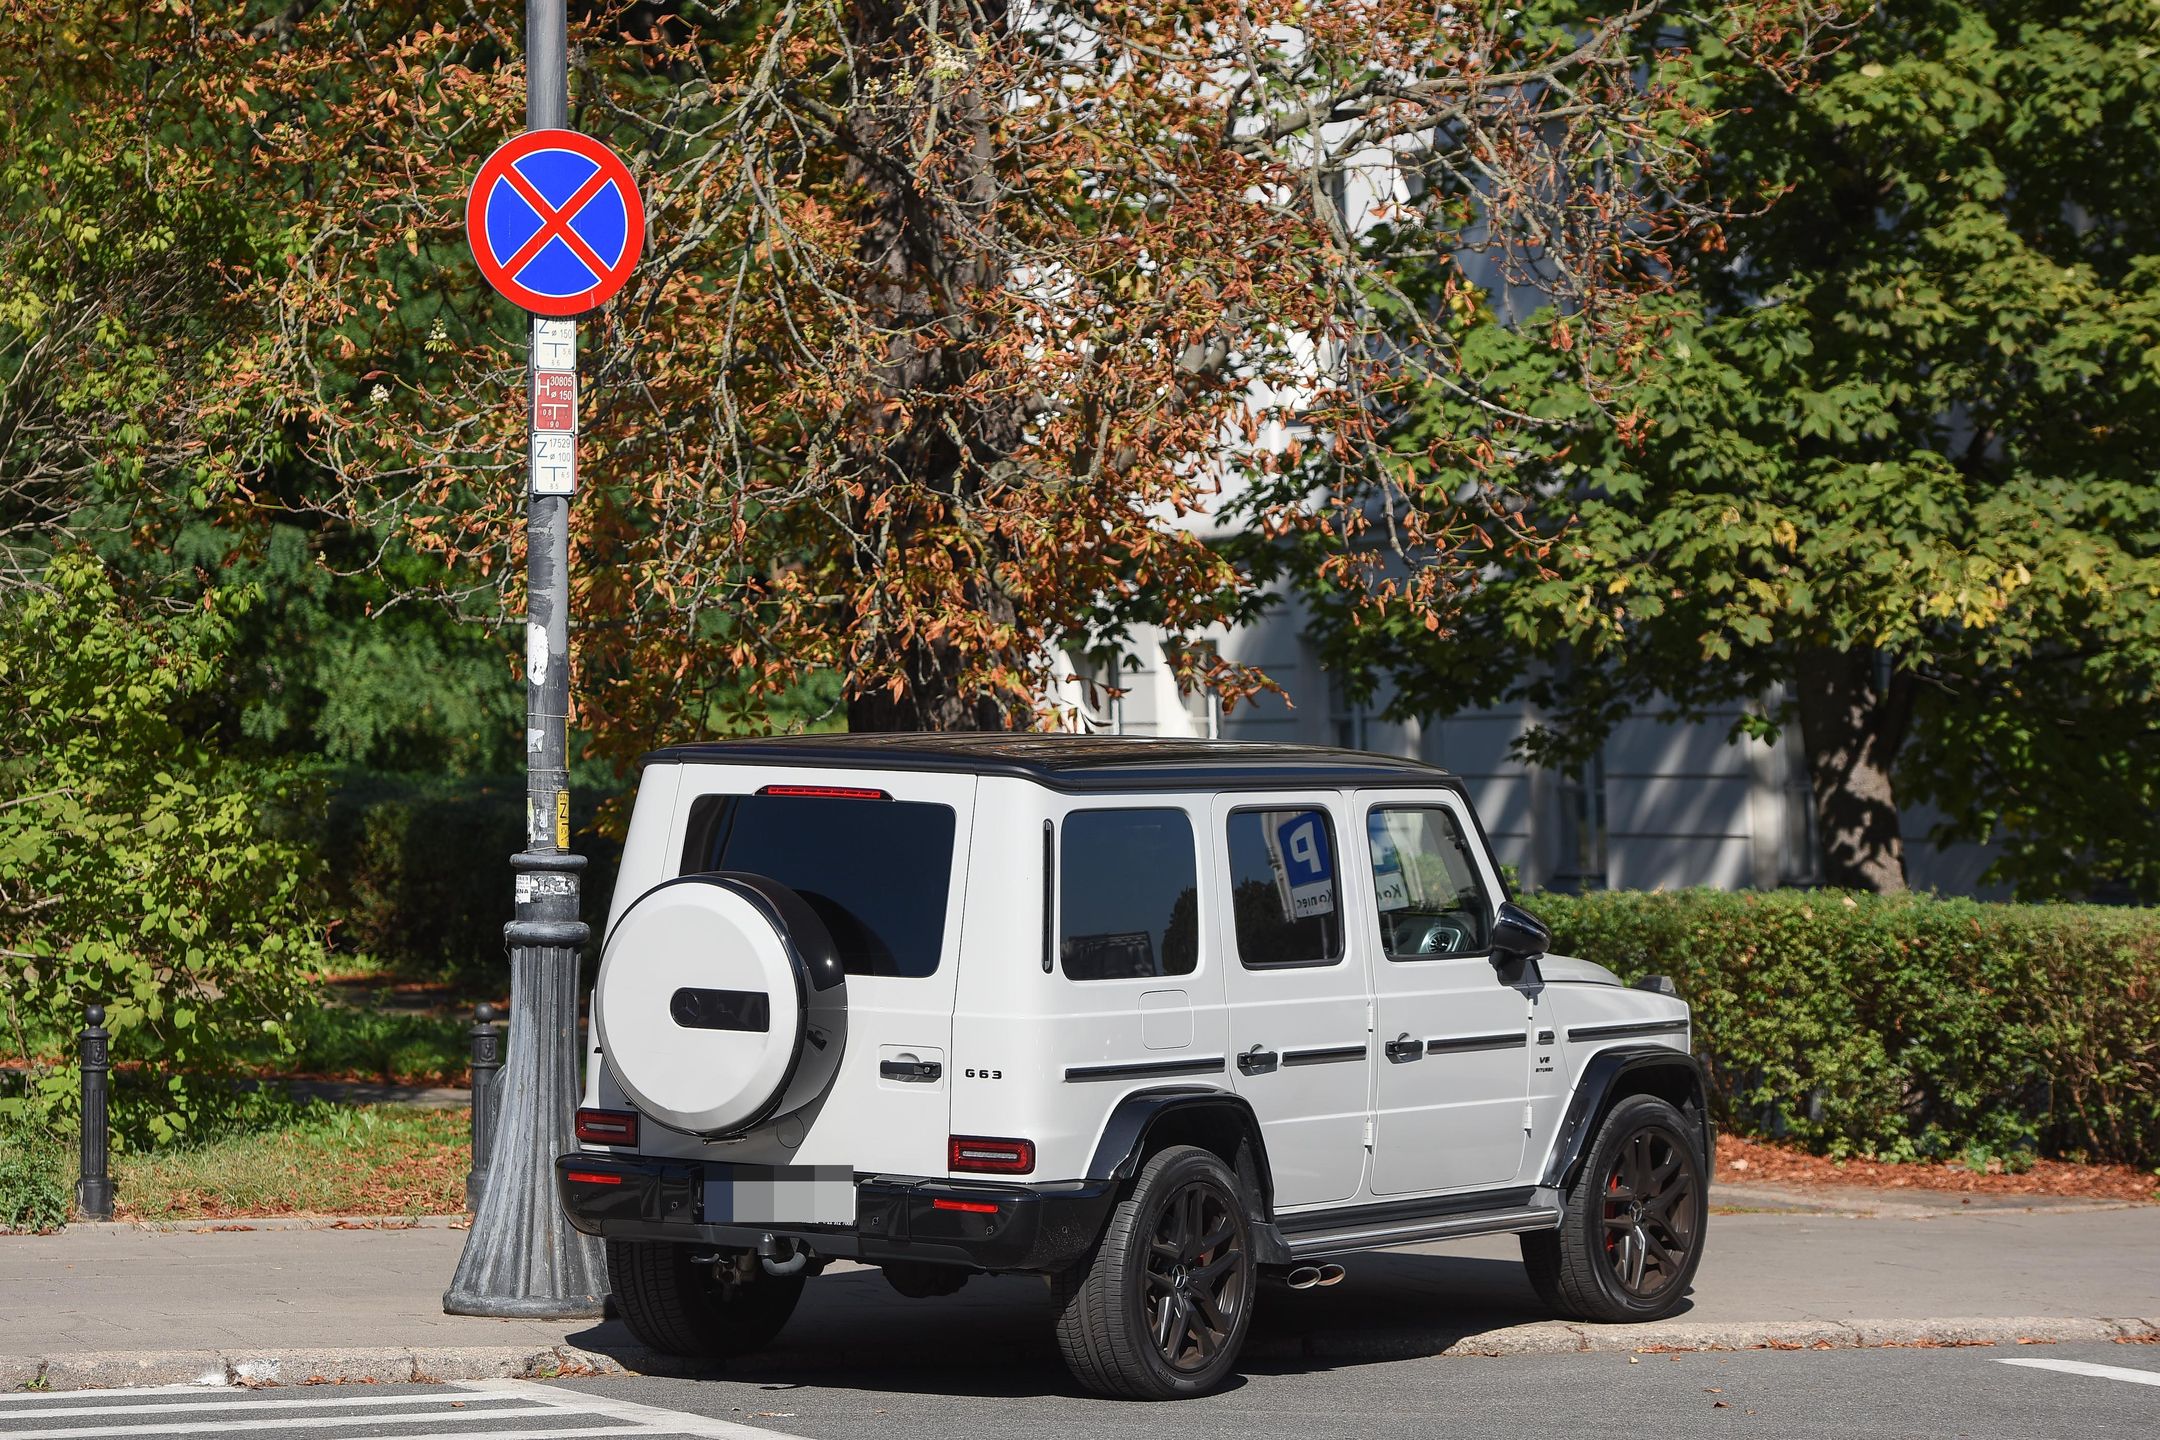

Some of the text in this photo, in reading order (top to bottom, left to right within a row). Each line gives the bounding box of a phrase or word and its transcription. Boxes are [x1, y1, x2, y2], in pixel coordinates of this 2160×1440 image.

[560, 329, 573, 339] 150
[550, 376, 573, 387] 30805
[538, 379, 550, 396] H
[559, 390, 573, 400] 150
[549, 438, 571, 449] 17529
[537, 441, 548, 458] Z
[558, 452, 571, 462] 100
